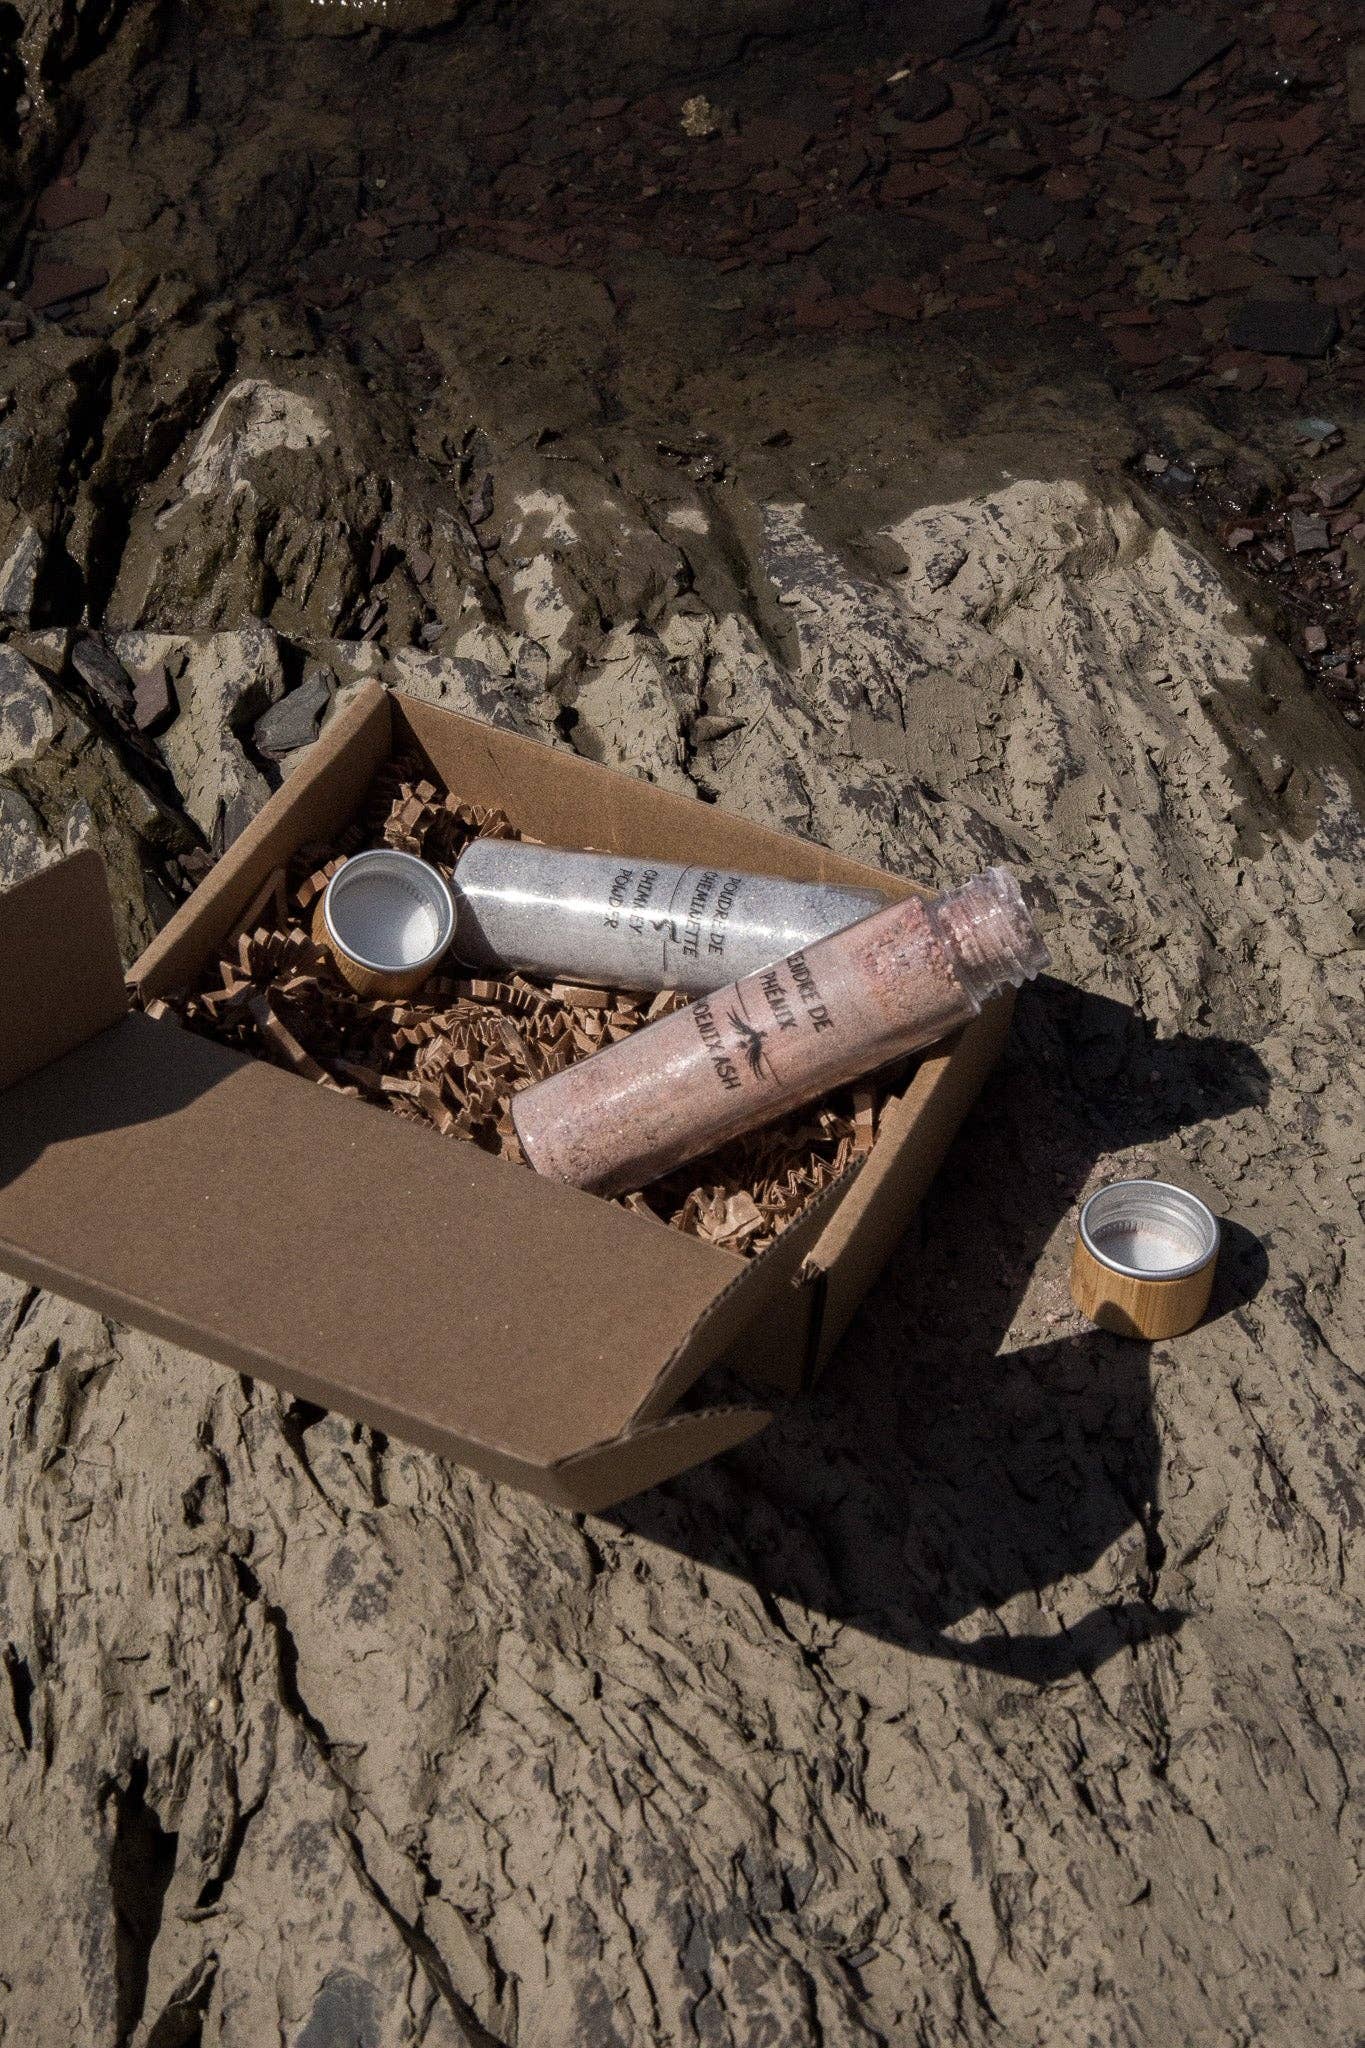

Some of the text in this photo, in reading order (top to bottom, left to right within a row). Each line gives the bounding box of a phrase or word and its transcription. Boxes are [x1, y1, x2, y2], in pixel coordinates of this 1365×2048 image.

[683, 871, 719, 958] CHEMINETTE
[708, 876, 741, 955] POUDRE DE
[759, 970, 798, 1030] PHÉNIX
[786, 951, 834, 1033] ENDRE DE
[711, 1056, 741, 1090] ASH
